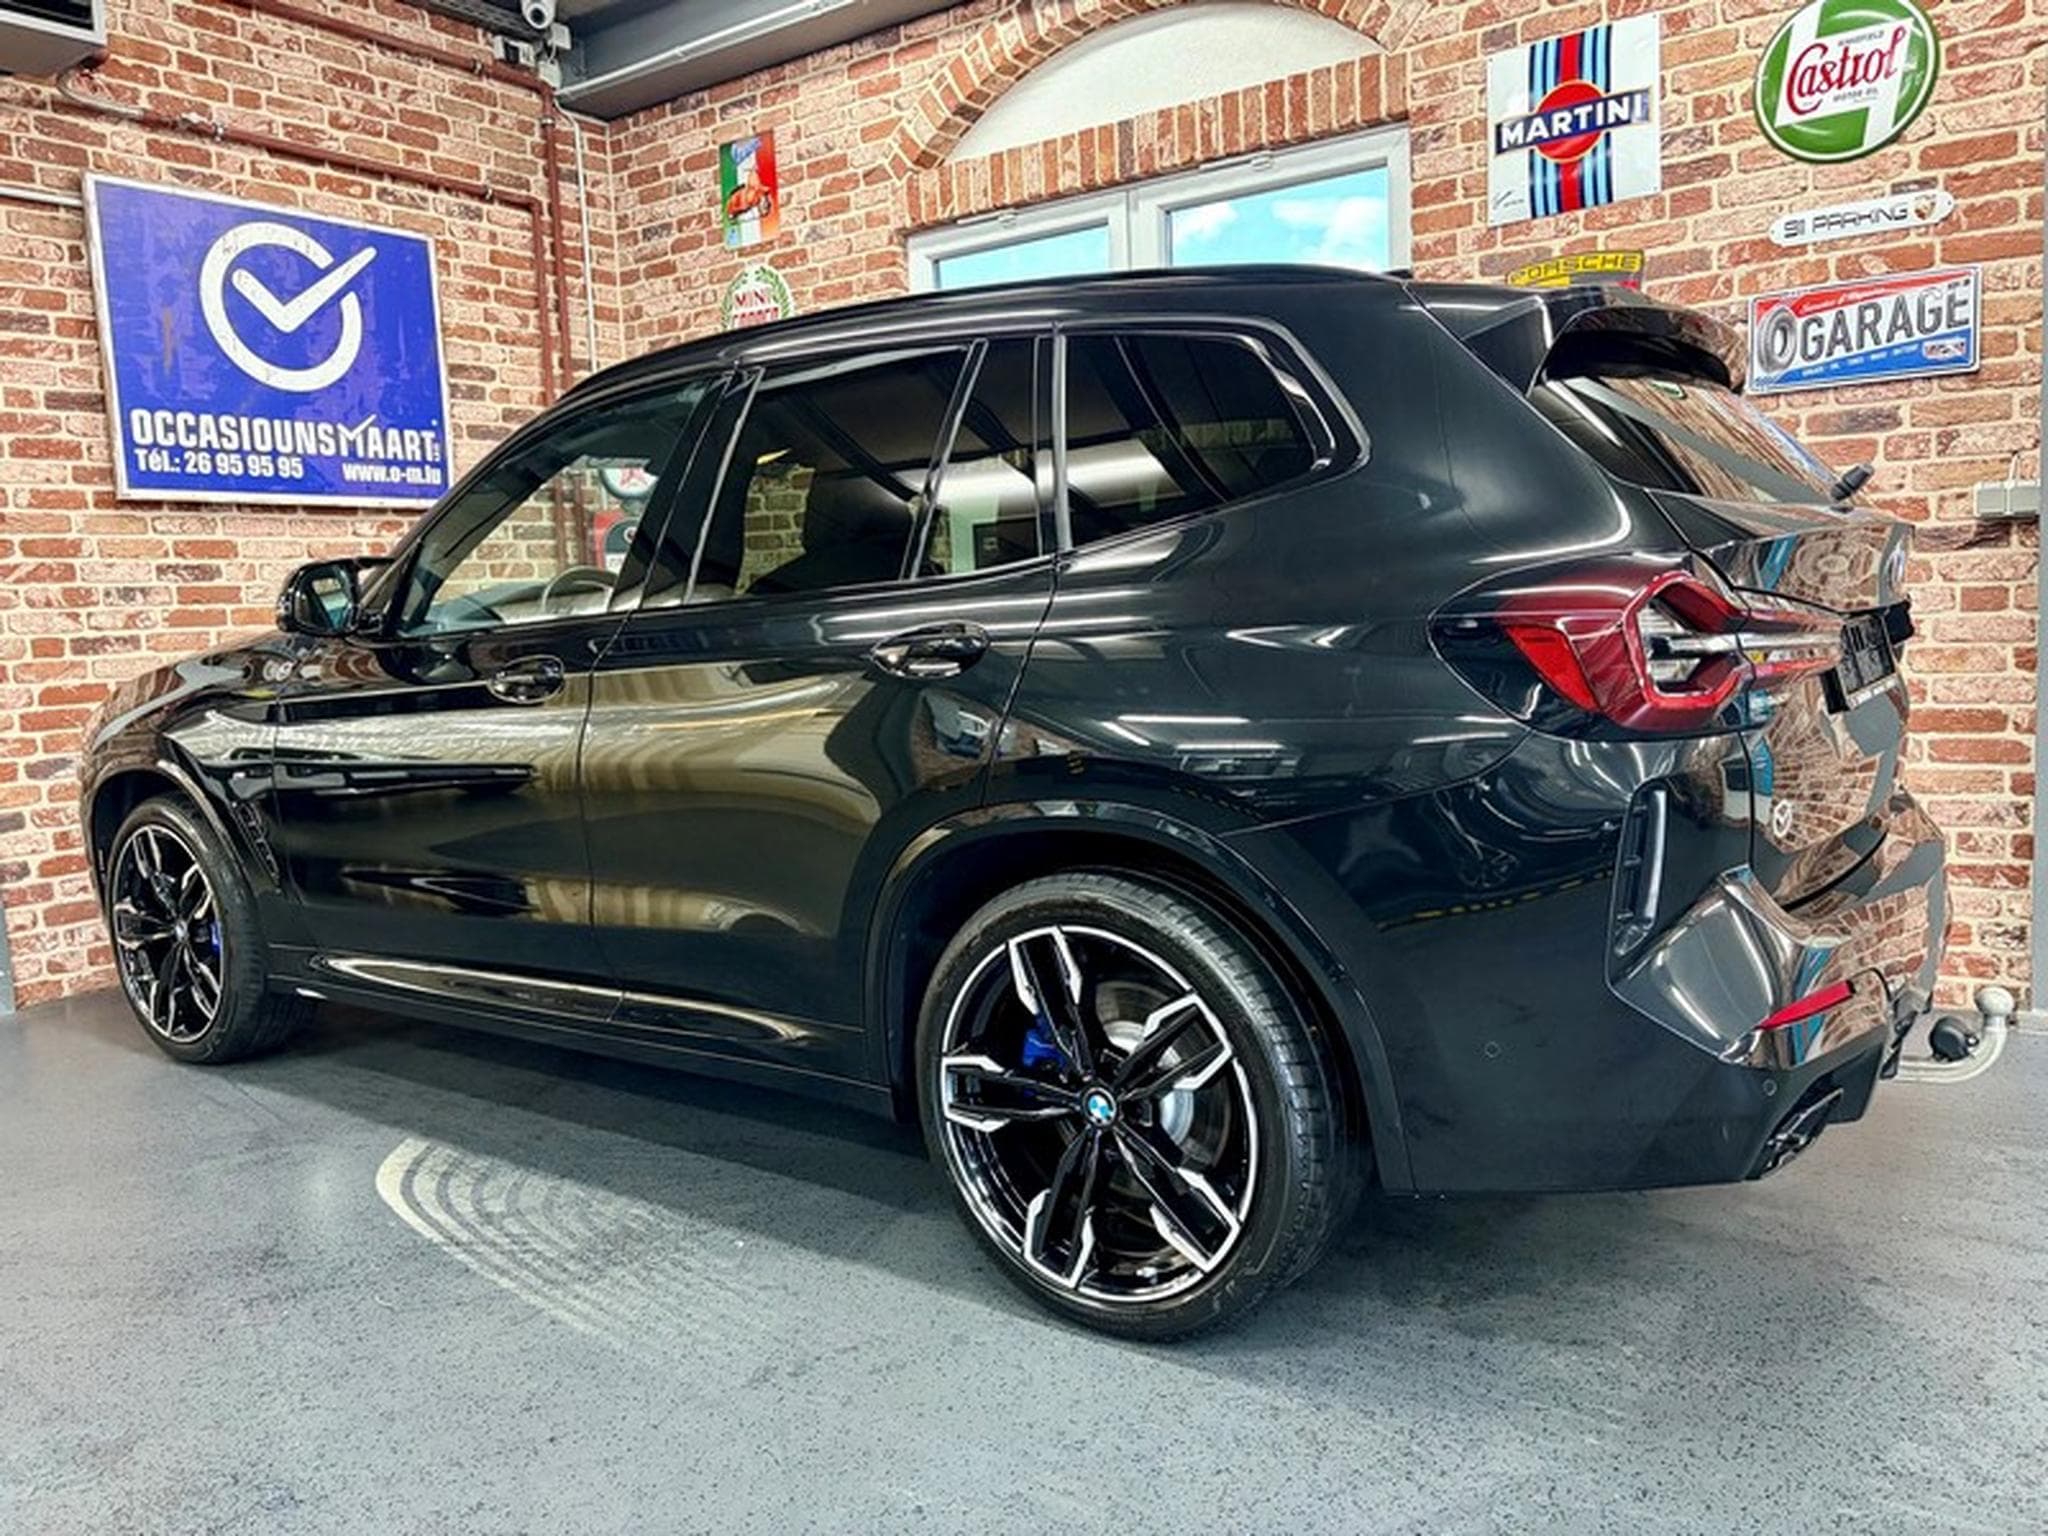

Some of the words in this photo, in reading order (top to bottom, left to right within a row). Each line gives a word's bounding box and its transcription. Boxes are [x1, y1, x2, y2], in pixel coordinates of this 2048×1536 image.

[1786, 25, 1907, 116] Castrol
[1502, 93, 1643, 149] MARTINI
[1812, 202, 1909, 233] PARKING
[1510, 255, 1639, 284] PORSCHE
[1800, 278, 1970, 362] GARAGE
[130, 409, 436, 462] OCCASIOUNSMAART
[184, 452, 212, 475] 26
[216, 454, 244, 477] 95
[247, 454, 275, 478] 95
[277, 456, 304, 479] 95
[342, 462, 441, 485] www.o-m.lu
